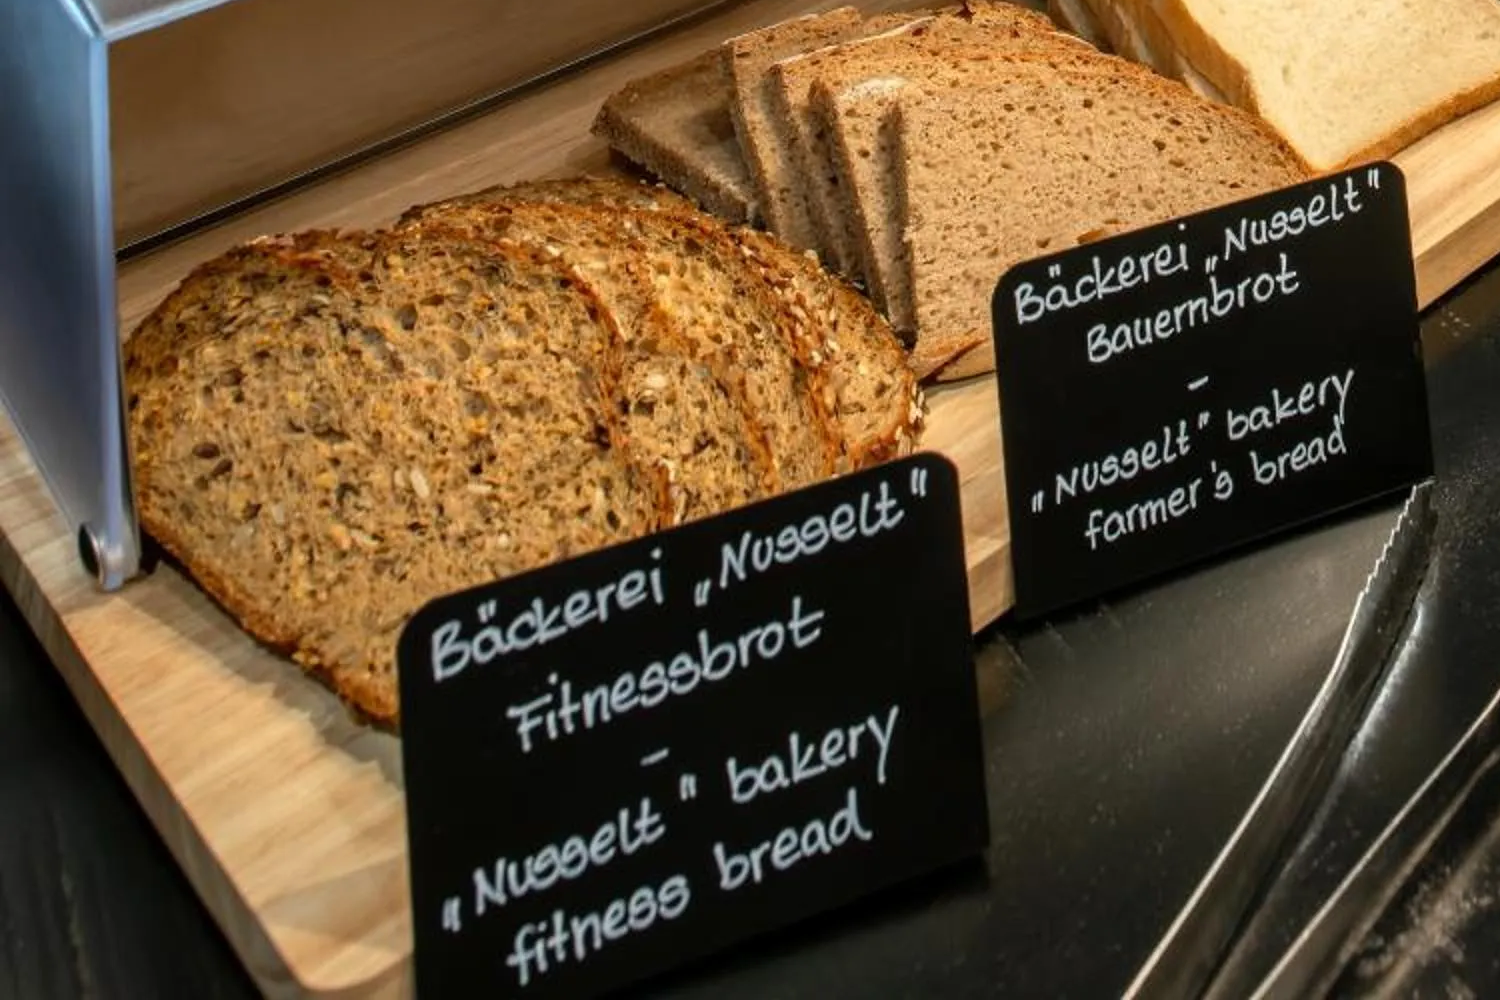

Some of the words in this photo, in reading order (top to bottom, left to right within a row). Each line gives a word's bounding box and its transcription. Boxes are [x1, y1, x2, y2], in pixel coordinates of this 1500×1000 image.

[1014, 224, 1189, 324] Bäckerei
[1087, 254, 1300, 363] Bauernbrot
[1228, 369, 1355, 440] bakery
[1084, 461, 1234, 550] farmer's
[1251, 416, 1347, 485] bread
[432, 548, 663, 681] Bäckerei
[507, 597, 825, 752] Fitnessbrot
[727, 706, 899, 803] bakery
[507, 874, 690, 985] fitness
[714, 788, 872, 890] bread
